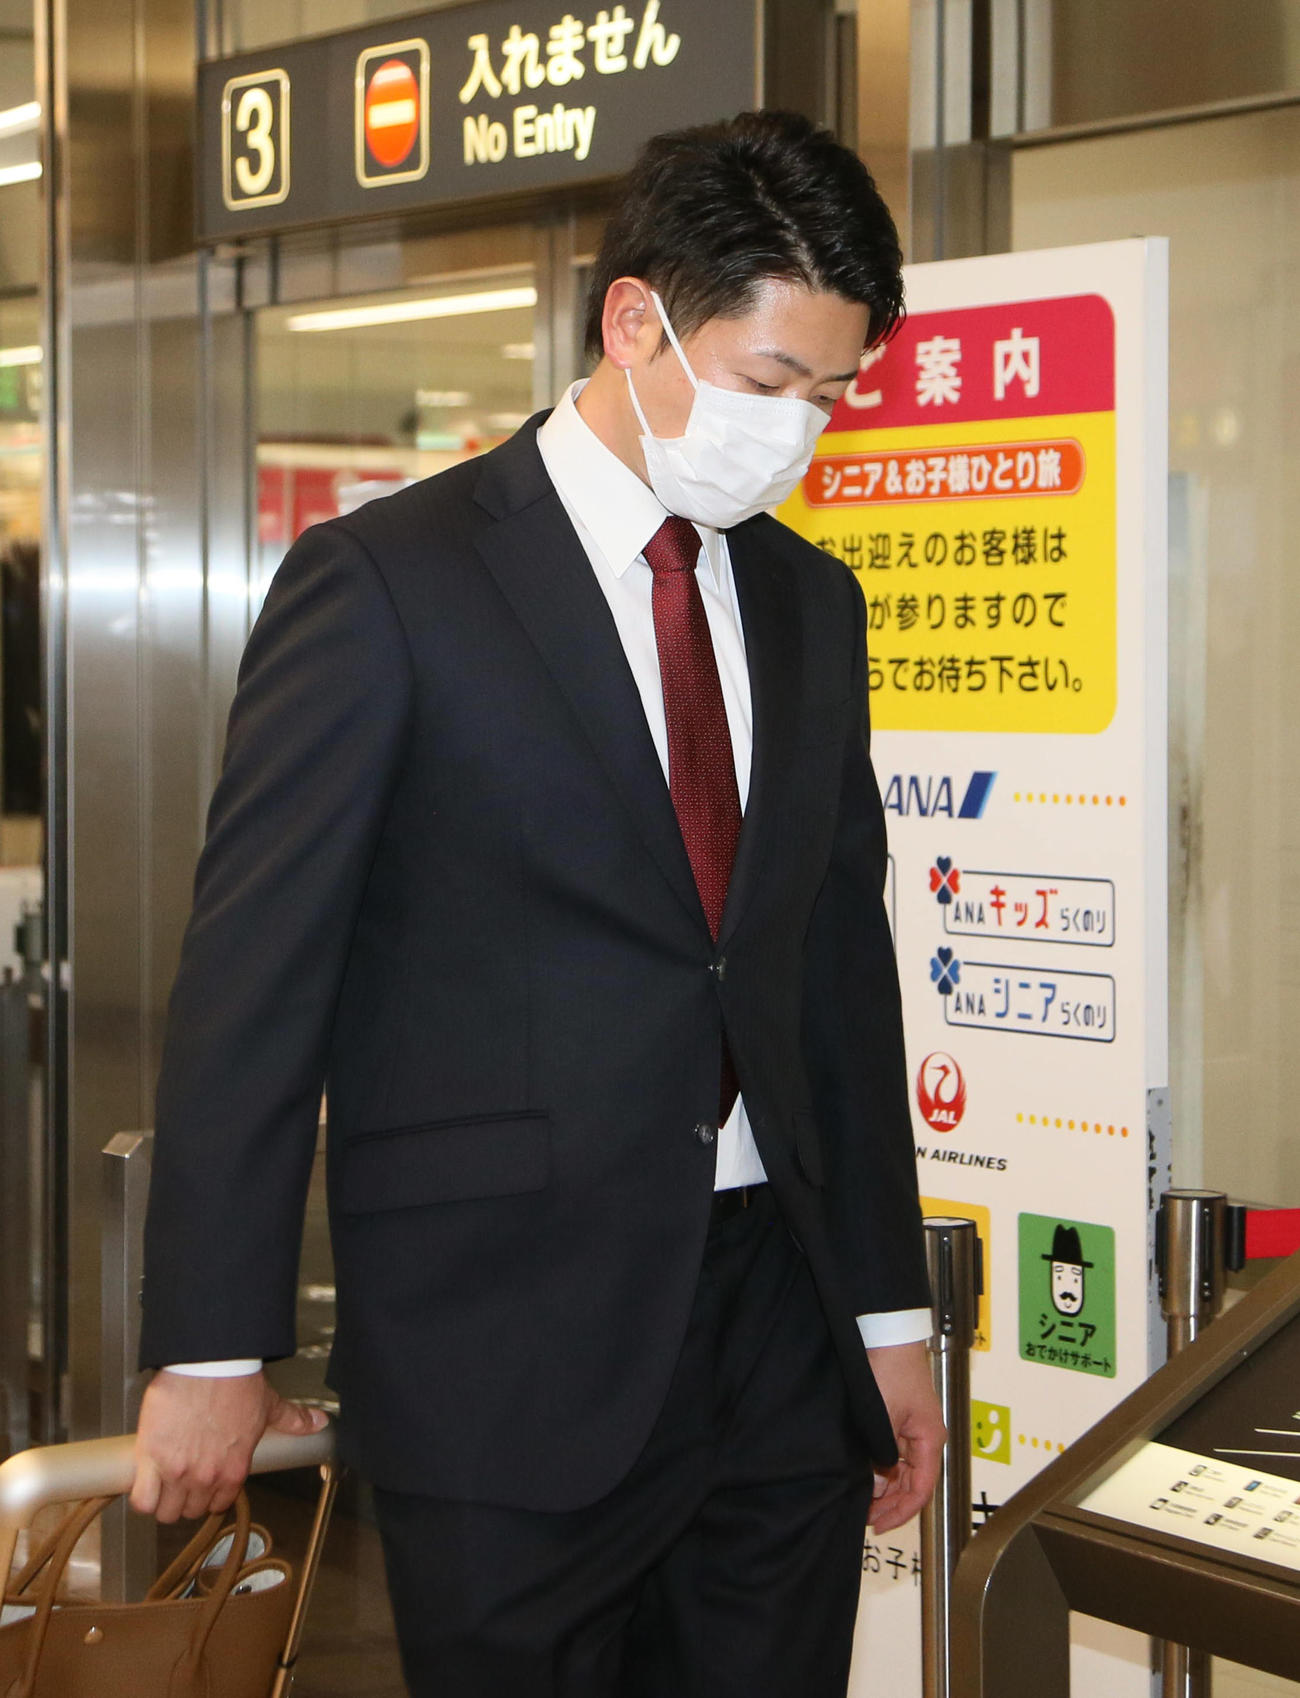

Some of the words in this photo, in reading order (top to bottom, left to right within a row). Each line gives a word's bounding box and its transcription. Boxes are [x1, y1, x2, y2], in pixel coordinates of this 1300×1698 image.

[458, 0, 681, 104] 入れません
[235, 87, 274, 195] 3
[463, 113, 508, 166] No
[513, 103, 596, 161] Entry
[821, 448, 1062, 500] シニア&お子様ひとり旅
[868, 592, 1069, 631] が参りますので
[884, 773, 954, 819] ANA
[953, 901, 986, 925] ANA
[989, 885, 1059, 930] キッズ
[1060, 907, 1107, 934] らくのり
[954, 991, 987, 1017] ANA
[993, 977, 1058, 1024] シニア
[1060, 1001, 1107, 1029] らくのり
[927, 1108, 958, 1126] JAL
[931, 1148, 1008, 1172] AIRLINES
[1039, 1313, 1097, 1347] シニア
[1025, 1342, 1112, 1373] おでかけサポート
